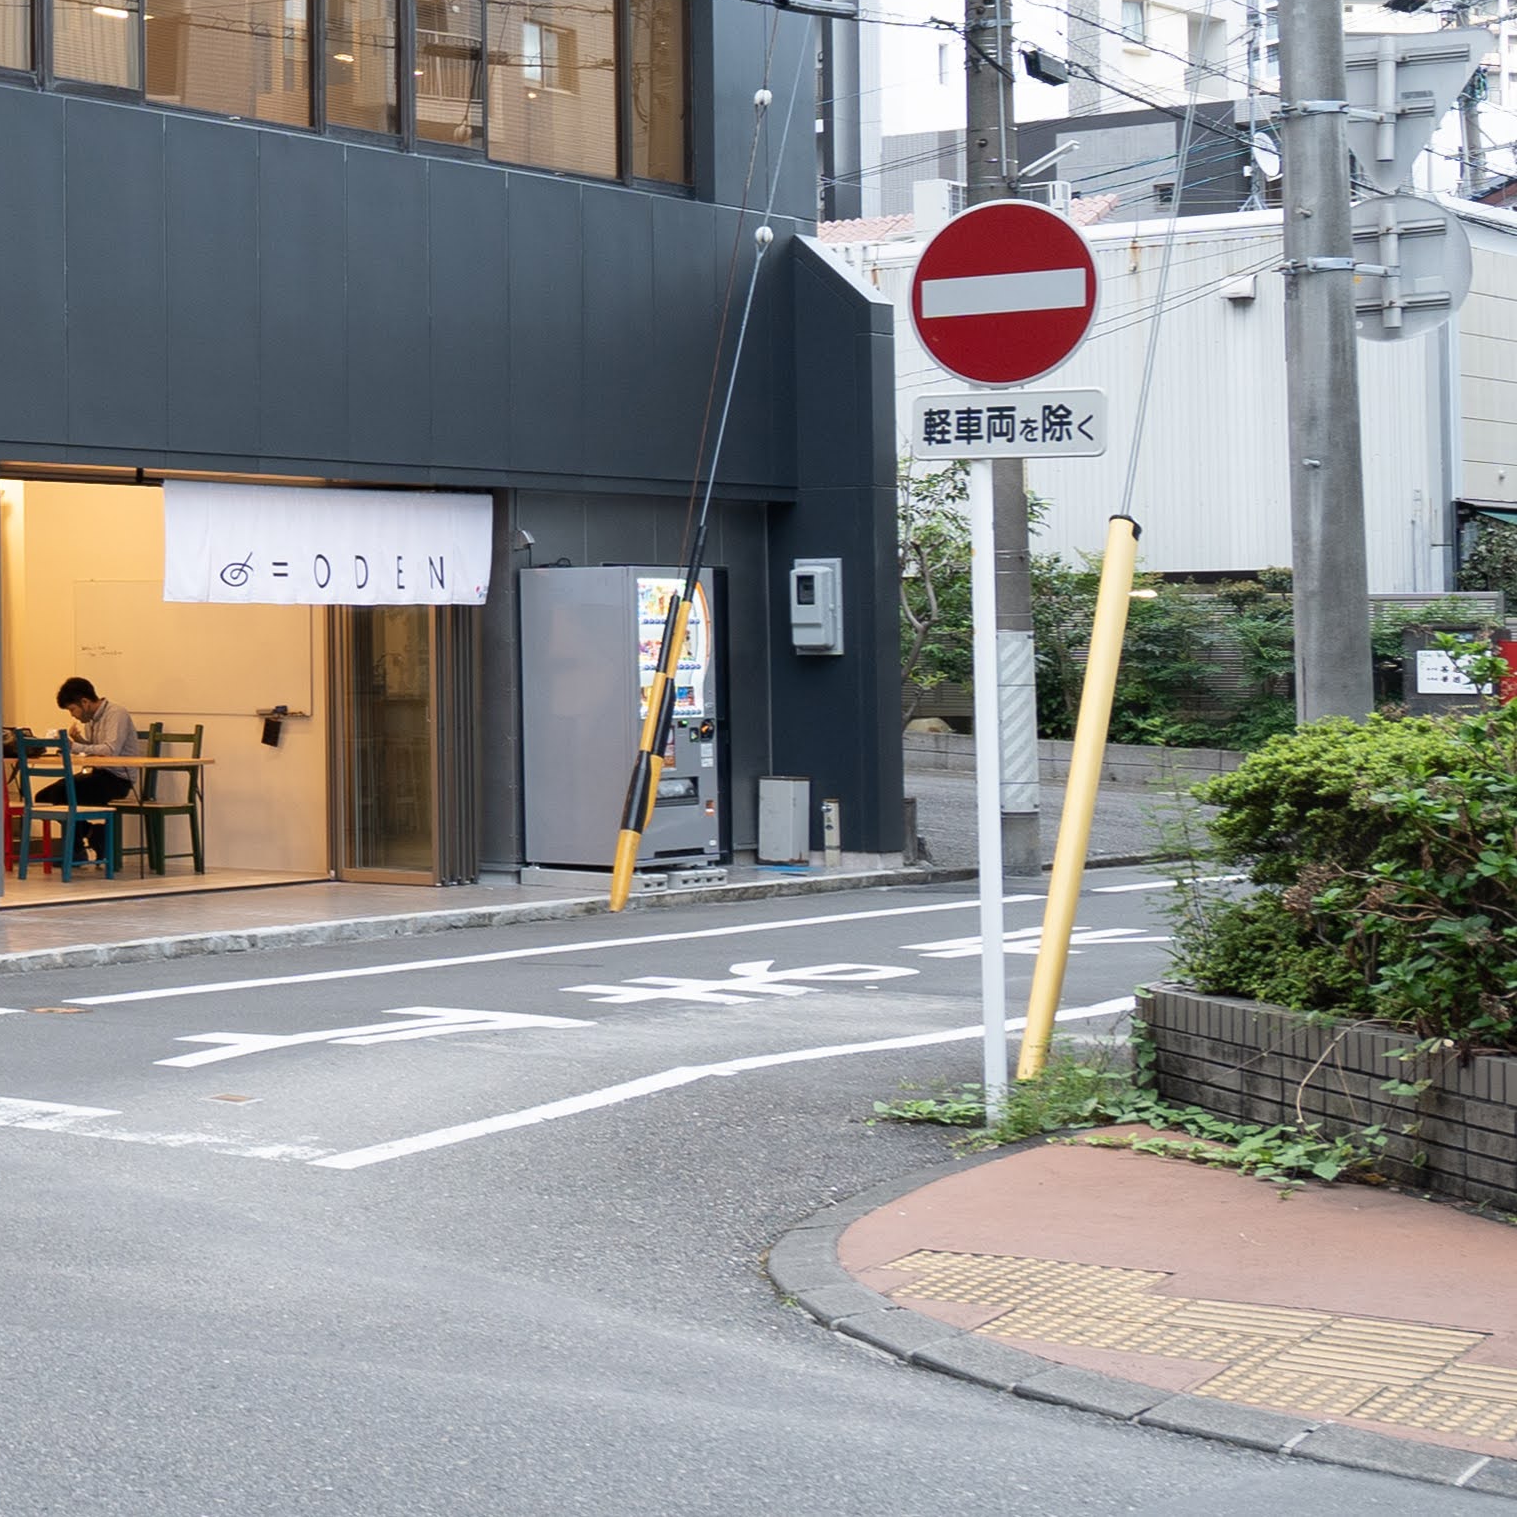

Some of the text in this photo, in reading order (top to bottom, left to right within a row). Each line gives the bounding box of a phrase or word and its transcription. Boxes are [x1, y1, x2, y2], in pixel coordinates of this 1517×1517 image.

[922, 403, 1094, 446] 軽車両を除く
